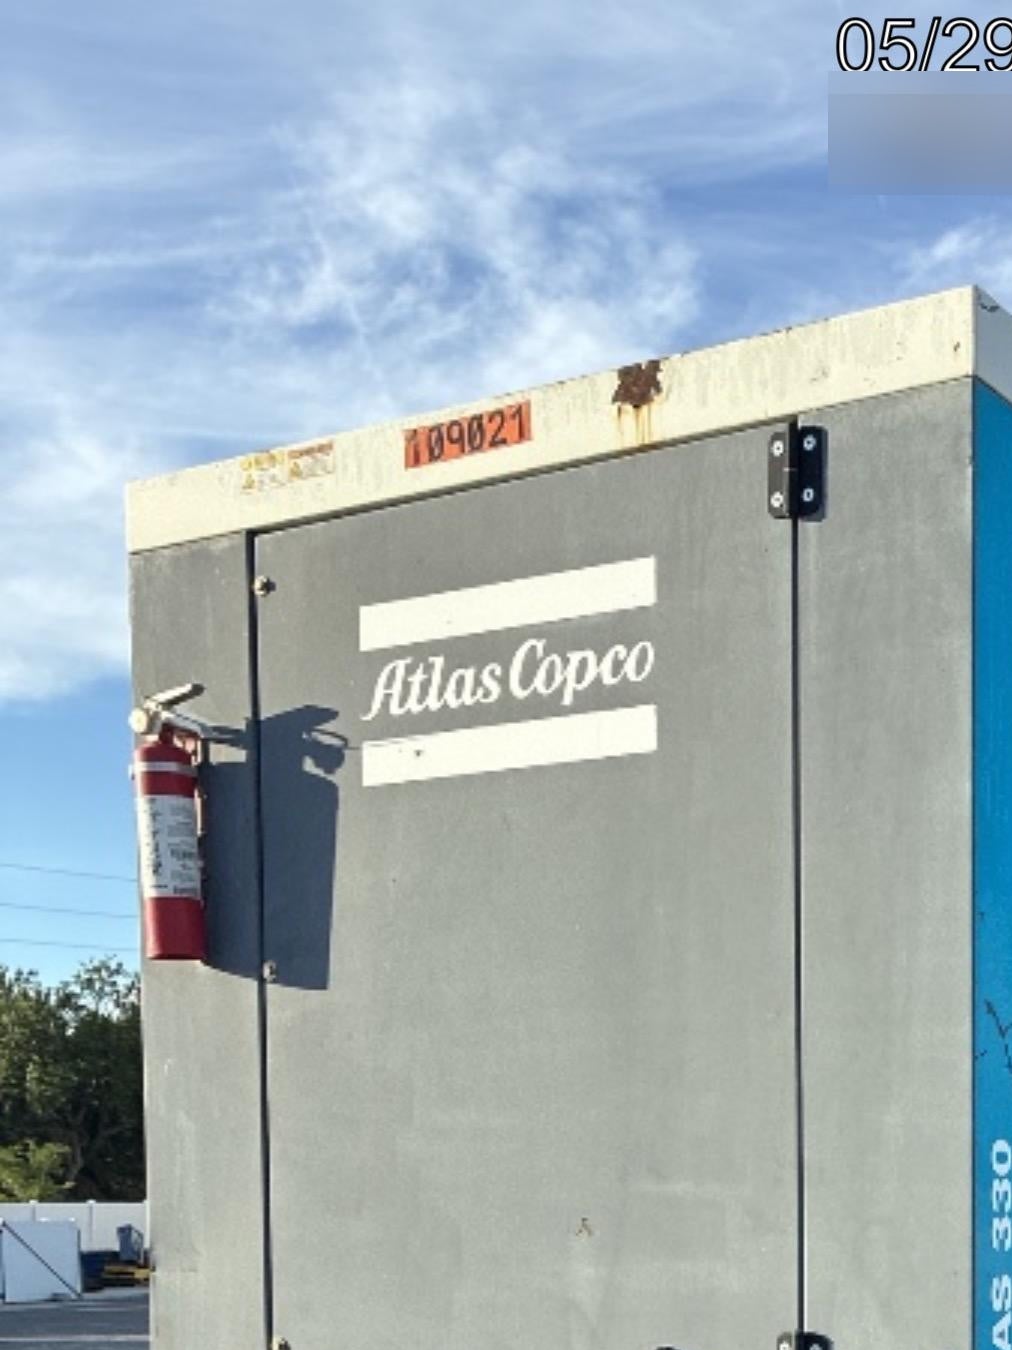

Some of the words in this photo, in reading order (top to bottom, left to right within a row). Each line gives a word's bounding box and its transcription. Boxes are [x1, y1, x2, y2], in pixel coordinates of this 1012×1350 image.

[405, 404, 525, 466] 109021
[360, 654, 502, 721] Atlas
[509, 638, 655, 706] Copco
[991, 1138, 1012, 1252] 330
